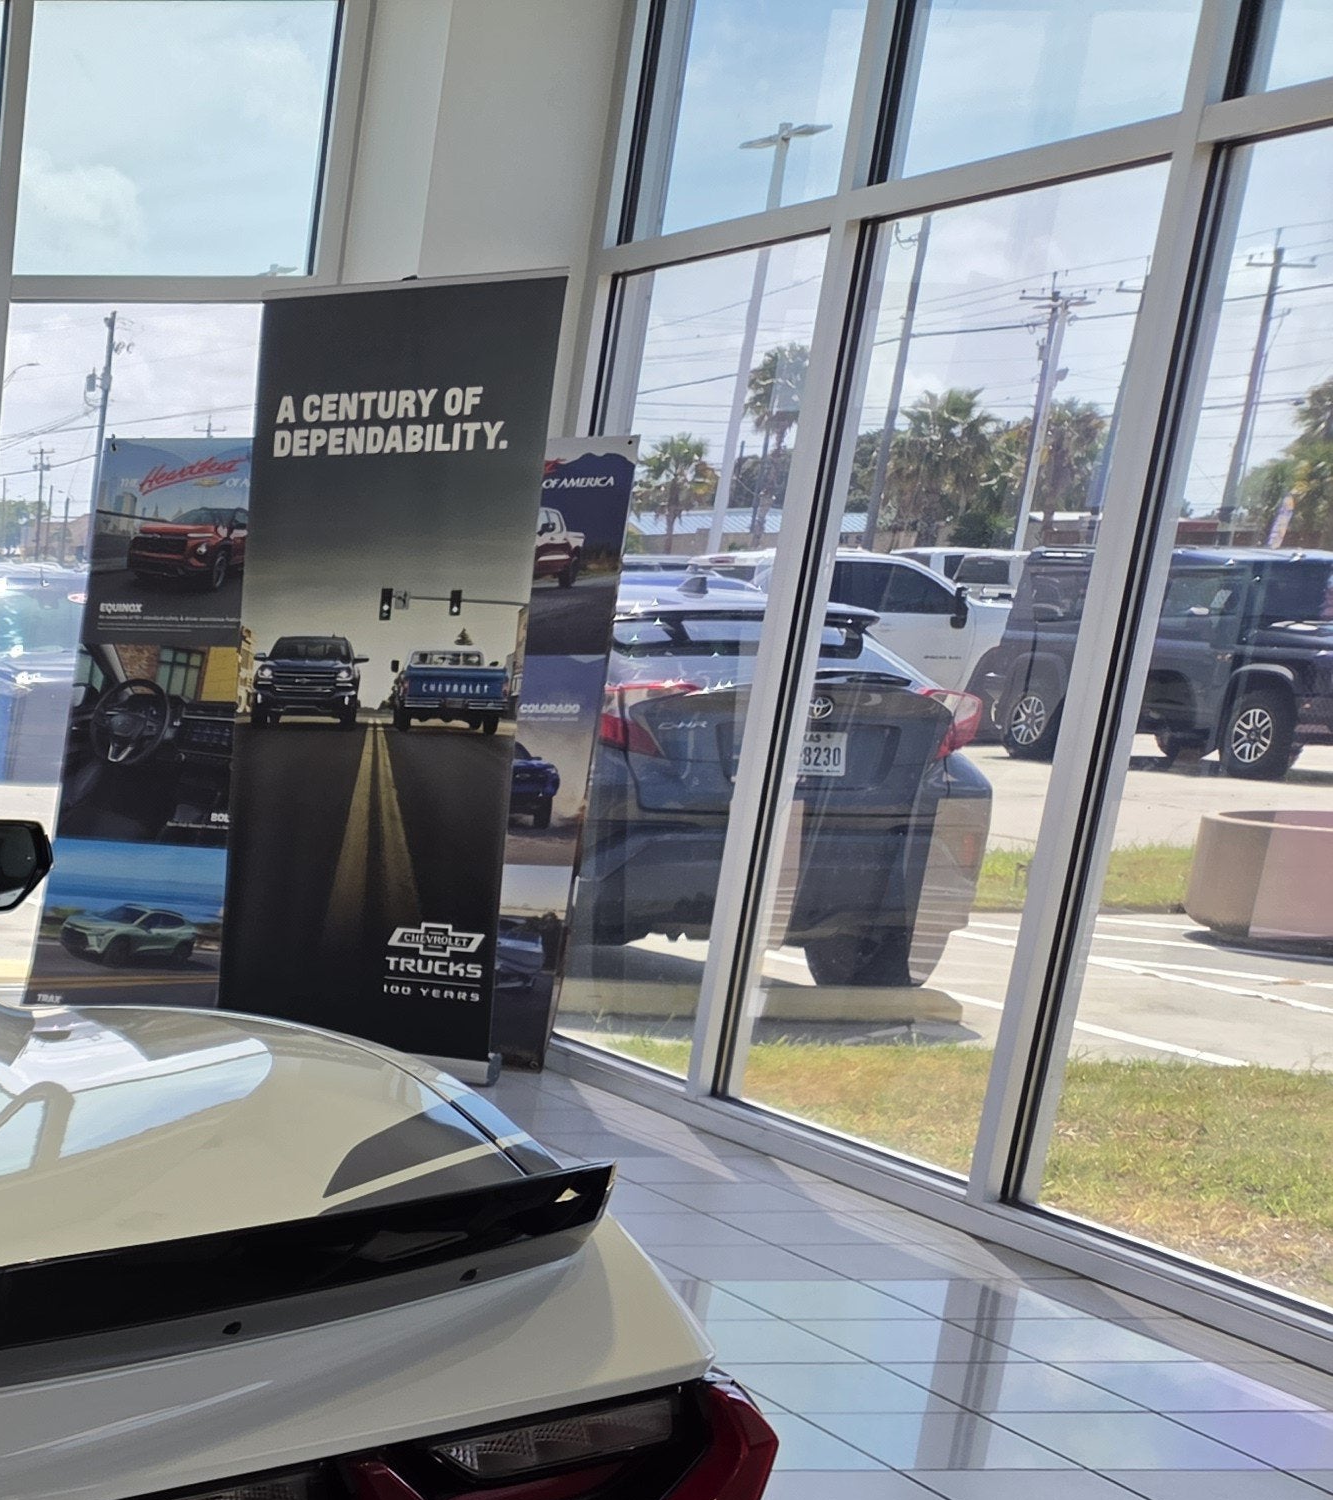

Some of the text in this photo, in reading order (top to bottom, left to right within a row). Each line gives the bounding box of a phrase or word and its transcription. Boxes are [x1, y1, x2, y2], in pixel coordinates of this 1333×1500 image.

[276, 386, 483, 424] A CENTURY OF
[273, 421, 508, 457] DEPENDABILITY.
[542, 475, 615, 489] OF AMERICA
[99, 602, 143, 614] EQUINOX
[421, 683, 489, 694] CHEVROLET
[519, 703, 580, 714] COLORADO
[801, 746, 841, 767] 8230
[211, 813, 230, 823] BOL
[403, 933, 469, 947] CHEVROLET
[385, 956, 483, 978] TRUCKS
[383, 984, 480, 1002] 100 YEARS
